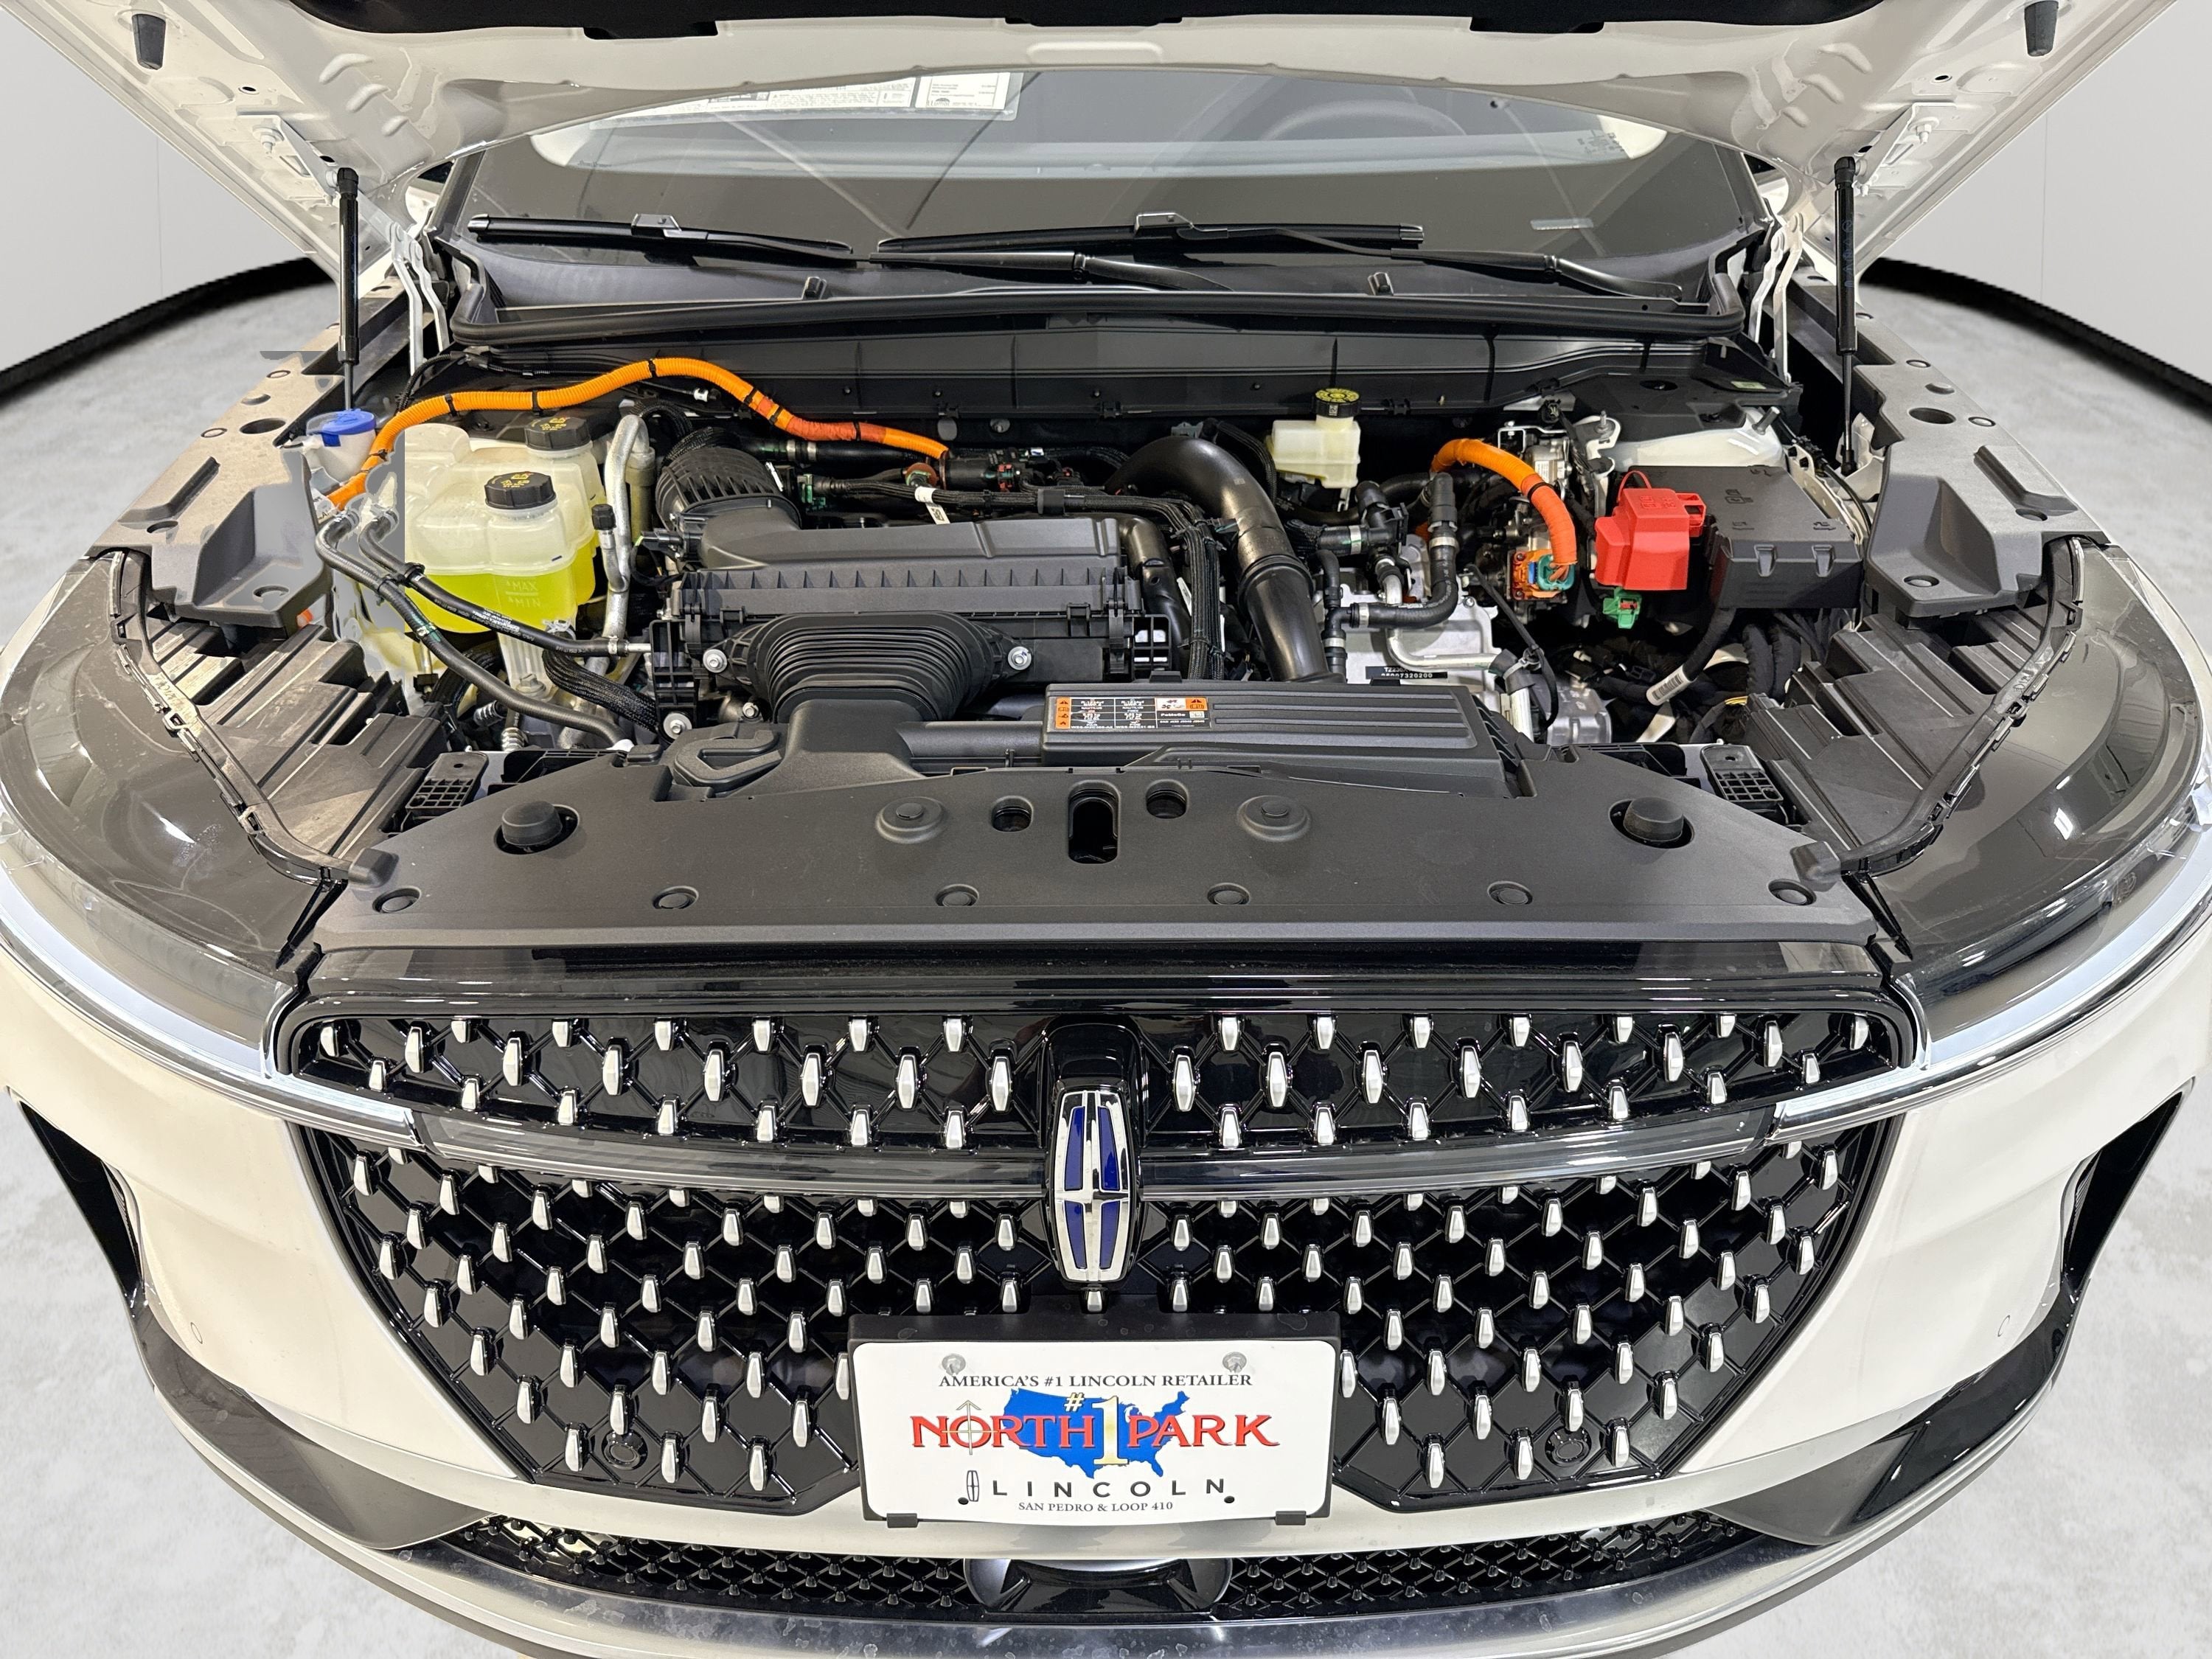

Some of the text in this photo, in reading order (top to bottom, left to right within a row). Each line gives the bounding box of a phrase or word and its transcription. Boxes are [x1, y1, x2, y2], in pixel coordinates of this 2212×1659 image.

[512, 580, 538, 591] MAX
[939, 1374, 1253, 1387] AMERICA'S #1 LINCOLN RETAILER
[910, 1415, 1096, 1448] NORTH
[1128, 1414, 1281, 1447] PARK
[992, 1478, 1225, 1498] LINCOLN
[1018, 1501, 1173, 1512] SAN PEDRO & LOOP 410
